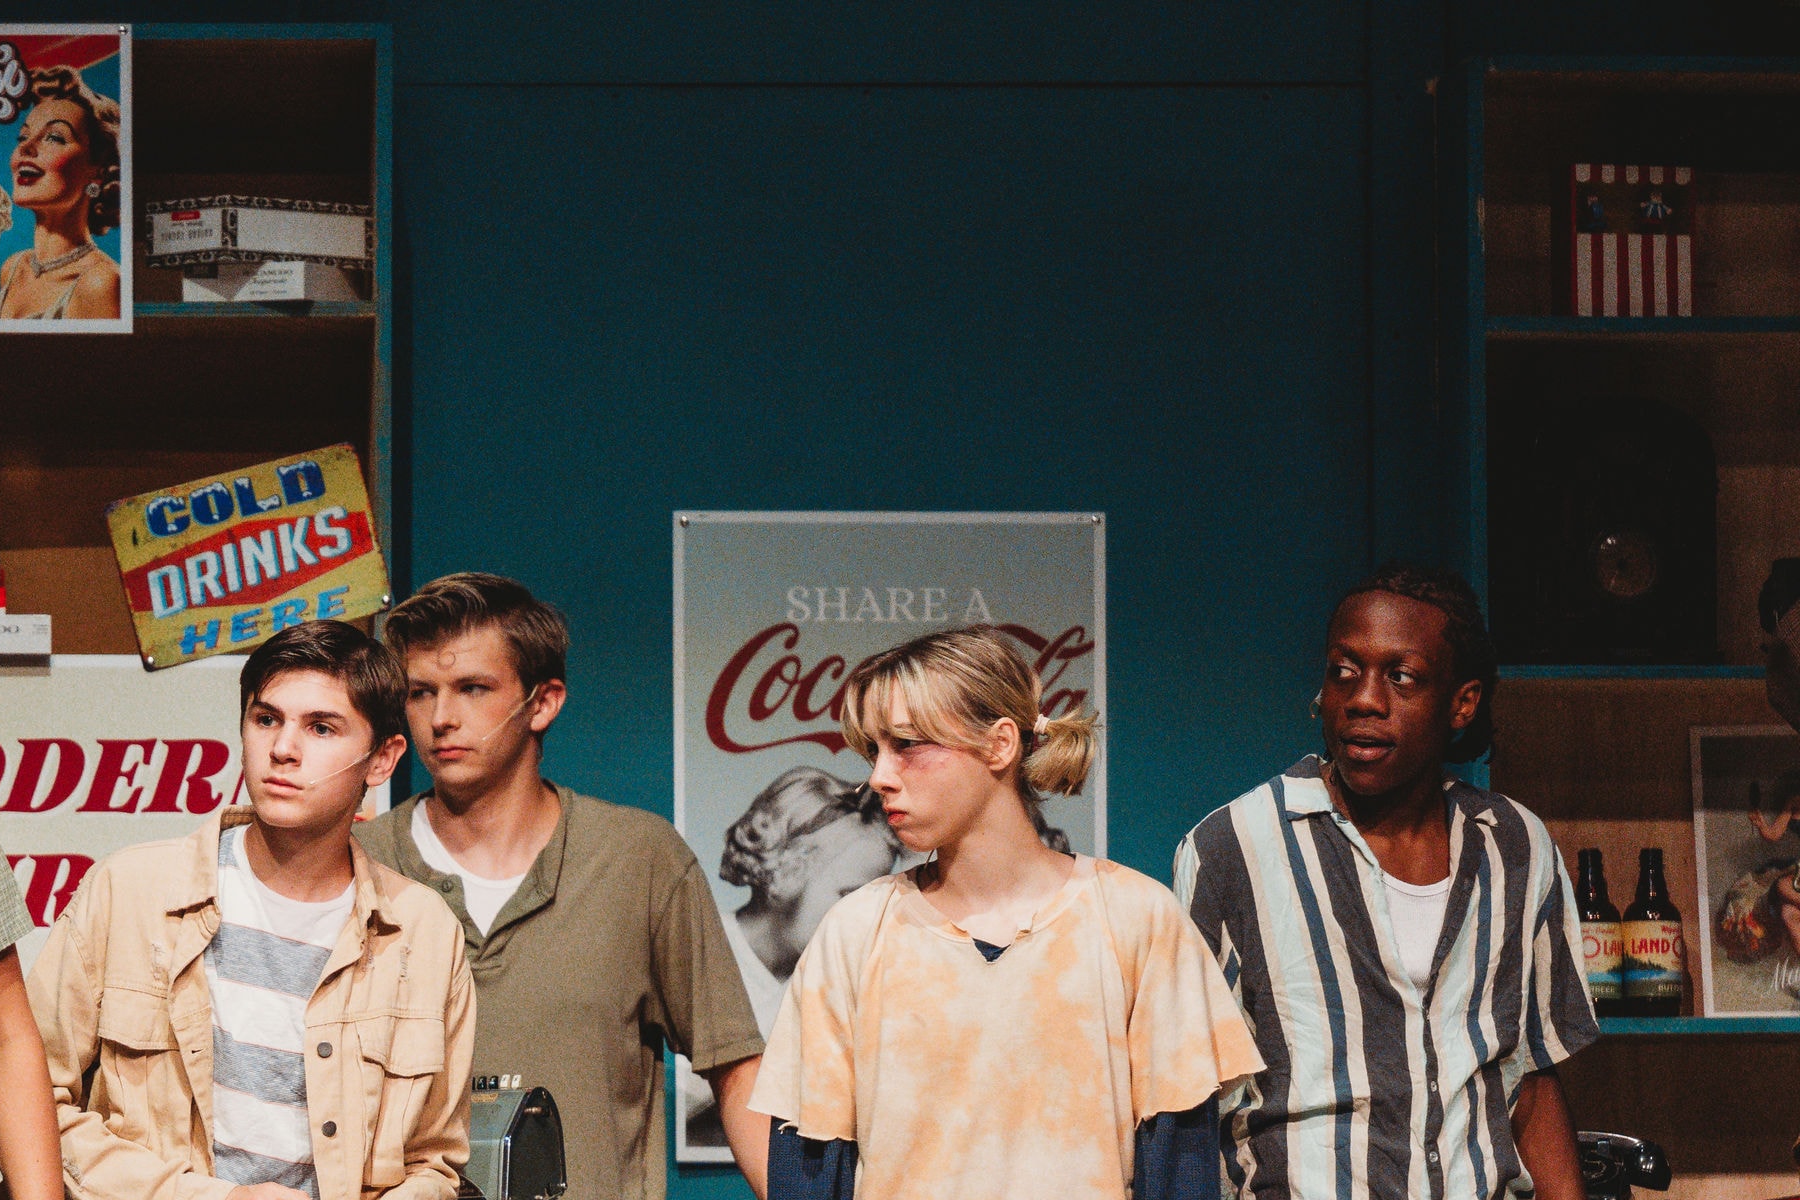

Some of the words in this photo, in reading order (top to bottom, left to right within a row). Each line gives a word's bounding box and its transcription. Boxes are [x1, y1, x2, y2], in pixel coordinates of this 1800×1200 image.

[146, 459, 327, 538] COLD
[147, 506, 353, 620] DRINKS
[178, 584, 349, 655] HERE
[785, 585, 952, 623] SHARE
[964, 587, 993, 623] A
[1630, 937, 1671, 956] LAND
